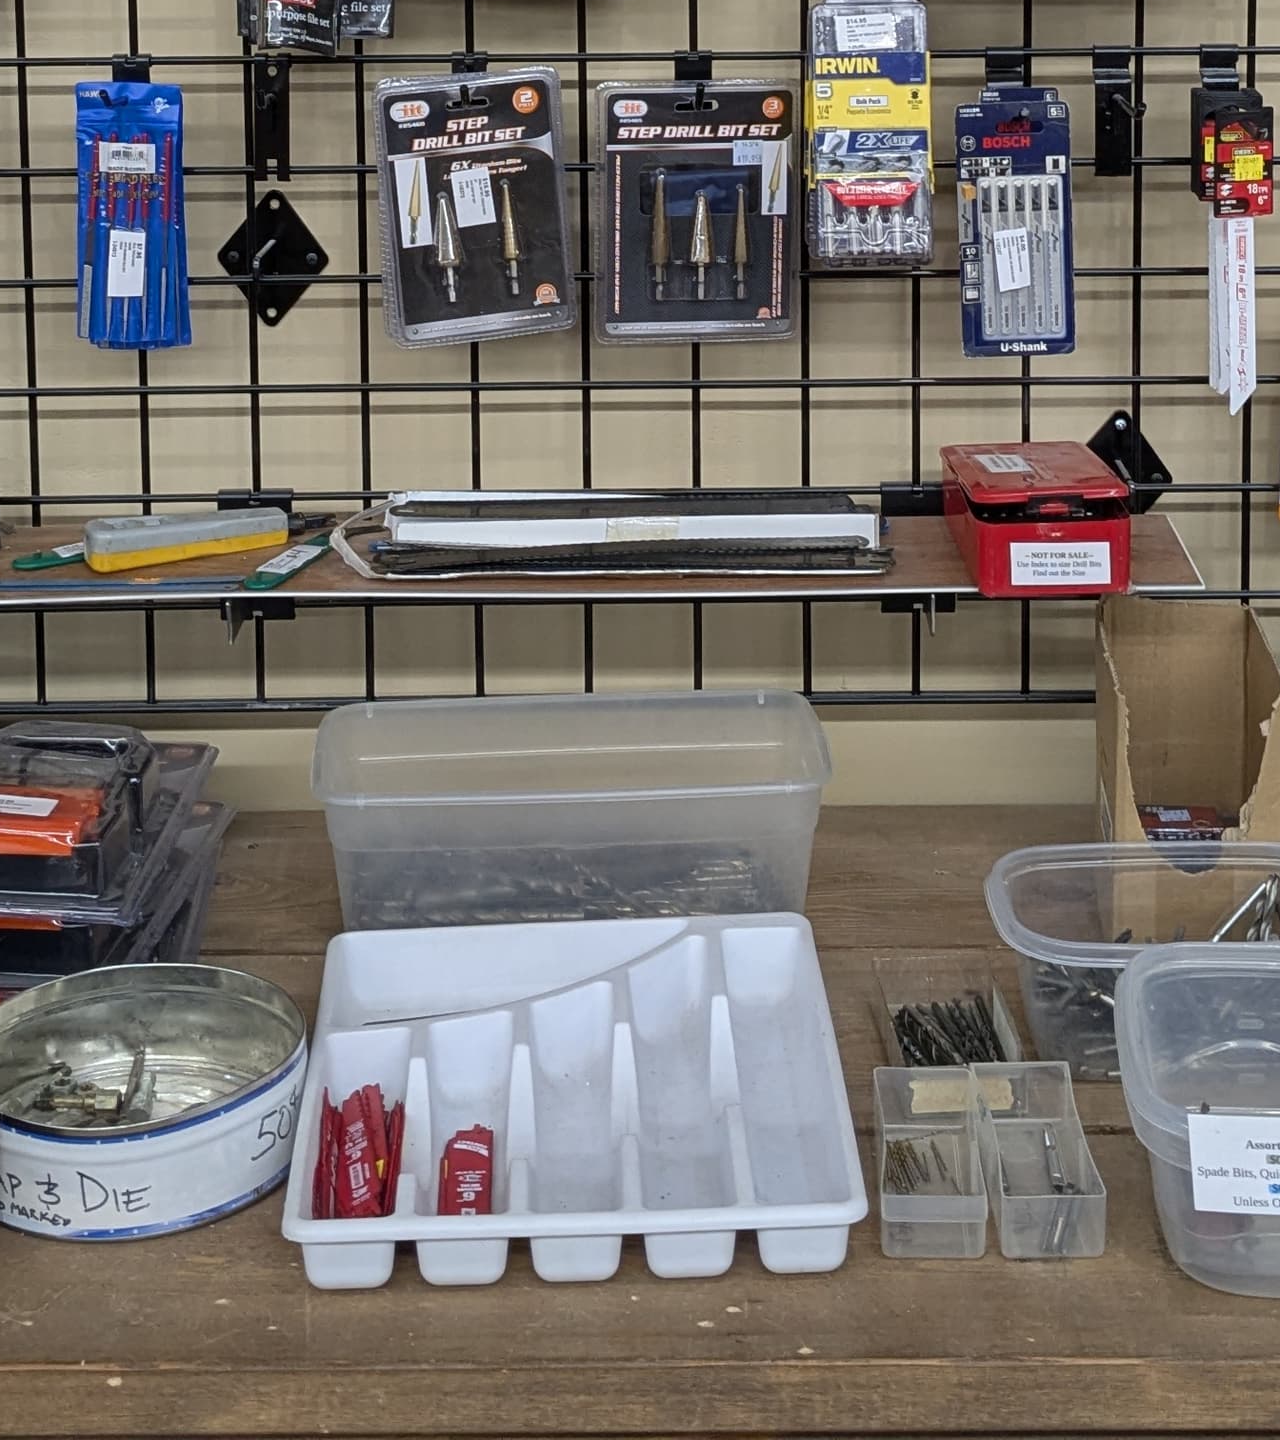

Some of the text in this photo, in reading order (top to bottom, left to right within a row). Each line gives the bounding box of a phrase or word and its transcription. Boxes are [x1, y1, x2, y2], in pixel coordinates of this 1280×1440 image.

[350, 1, 385, 13] file set
[815, 58, 879, 74] IRWIN
[520, 90, 533, 103] 2
[768, 100, 778, 111] 3
[447, 117, 488, 132] STEP
[617, 123, 782, 139] STEP DRILL BIT SET
[412, 126, 525, 152] DRILL BIT SET
[856, 133, 911, 147] 2X LIFE
[982, 136, 1030, 148] BOSCH
[1246, 183, 1258, 194] 18
[1000, 342, 1048, 352] U-Shank
[1031, 560, 1048, 568] Index
[1072, 560, 1087, 568] Drill
[1048, 569, 1059, 577] out
[1060, 569, 1070, 577] the
[1197, 1166, 1229, 1179] Spade
[1232, 1167, 1257, 1179] Bits,
[76, 1170, 152, 1213] DIE
[1233, 1196, 1269, 1208] Unless
[9, 1201, 72, 1228] MARKED
